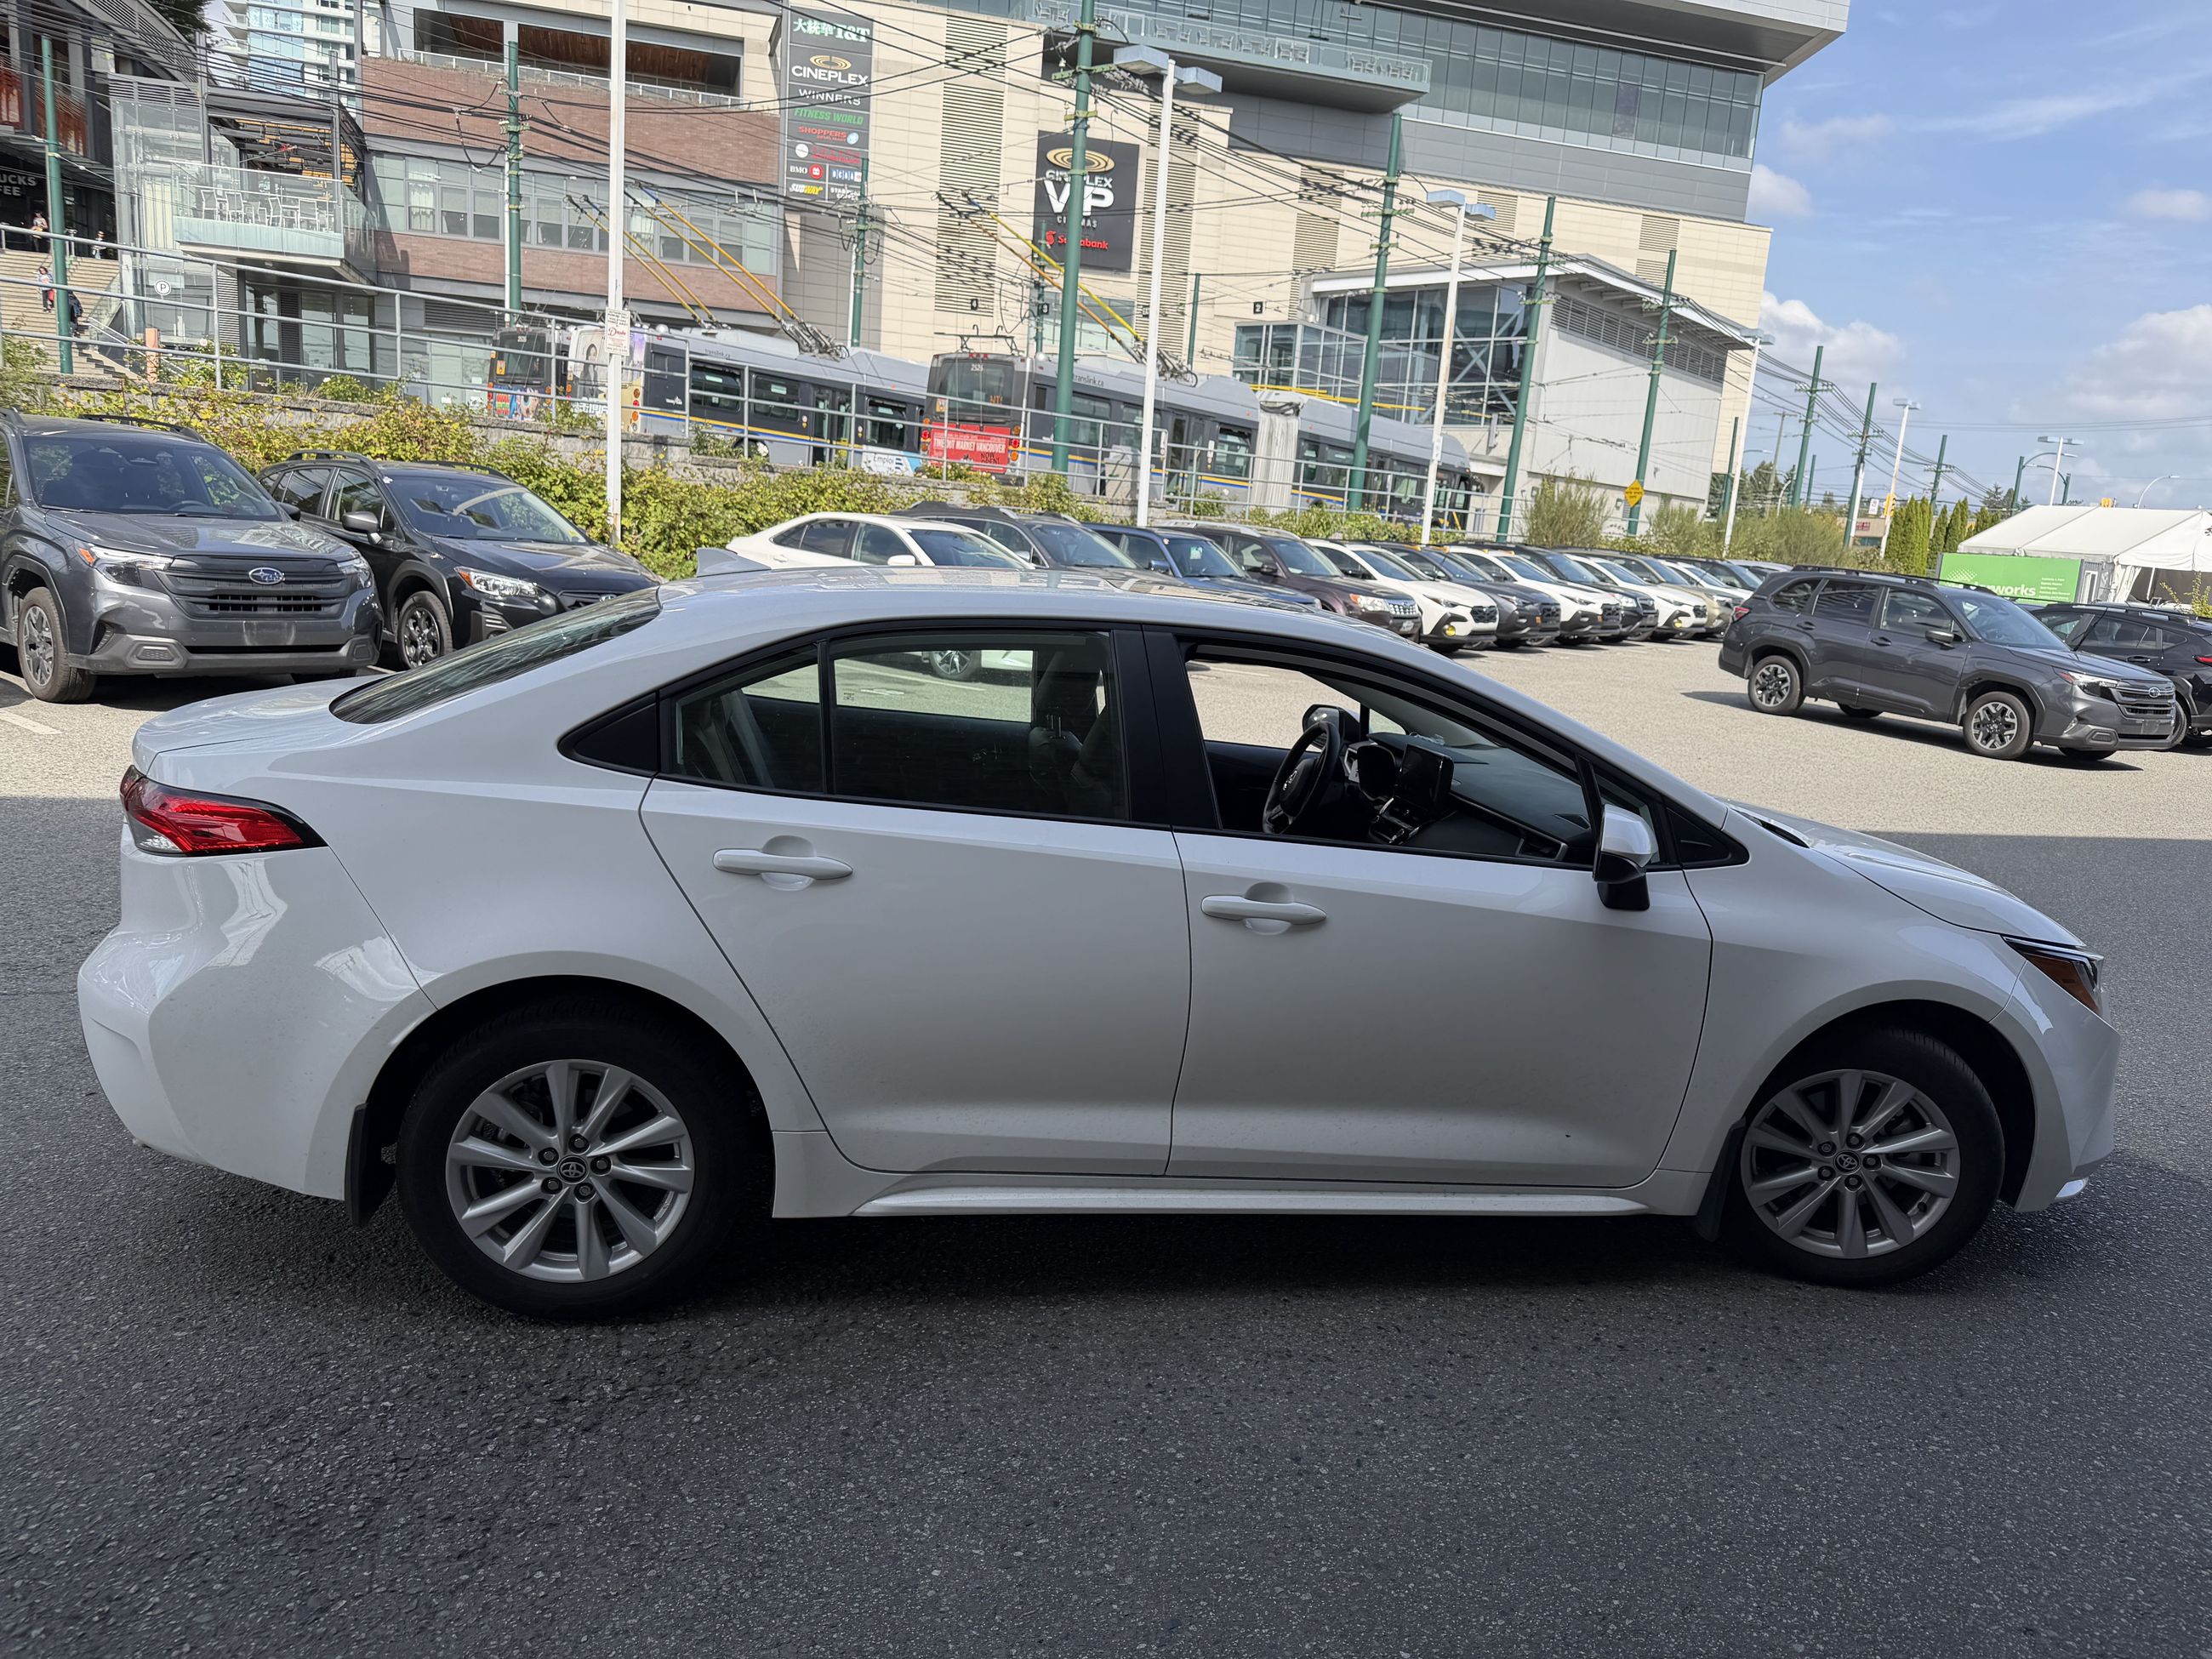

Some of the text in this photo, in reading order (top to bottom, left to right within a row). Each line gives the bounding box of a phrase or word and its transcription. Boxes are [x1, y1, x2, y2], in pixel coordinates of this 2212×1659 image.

[834, 23, 870, 43] T&T
[791, 66, 869, 87] CINEPLEX
[798, 88, 861, 106] WINNERS
[794, 108, 864, 125] FITNESS WORLD
[798, 125, 847, 138] SHOPPERS
[1045, 169, 1113, 189] CINLEX
[789, 183, 824, 196] SUBWAY
[1043, 179, 1115, 217] VP
[1057, 216, 1097, 229] CIAS
[1058, 235, 1109, 250] Sabank
[1075, 374, 1104, 386] ranslink.ca
